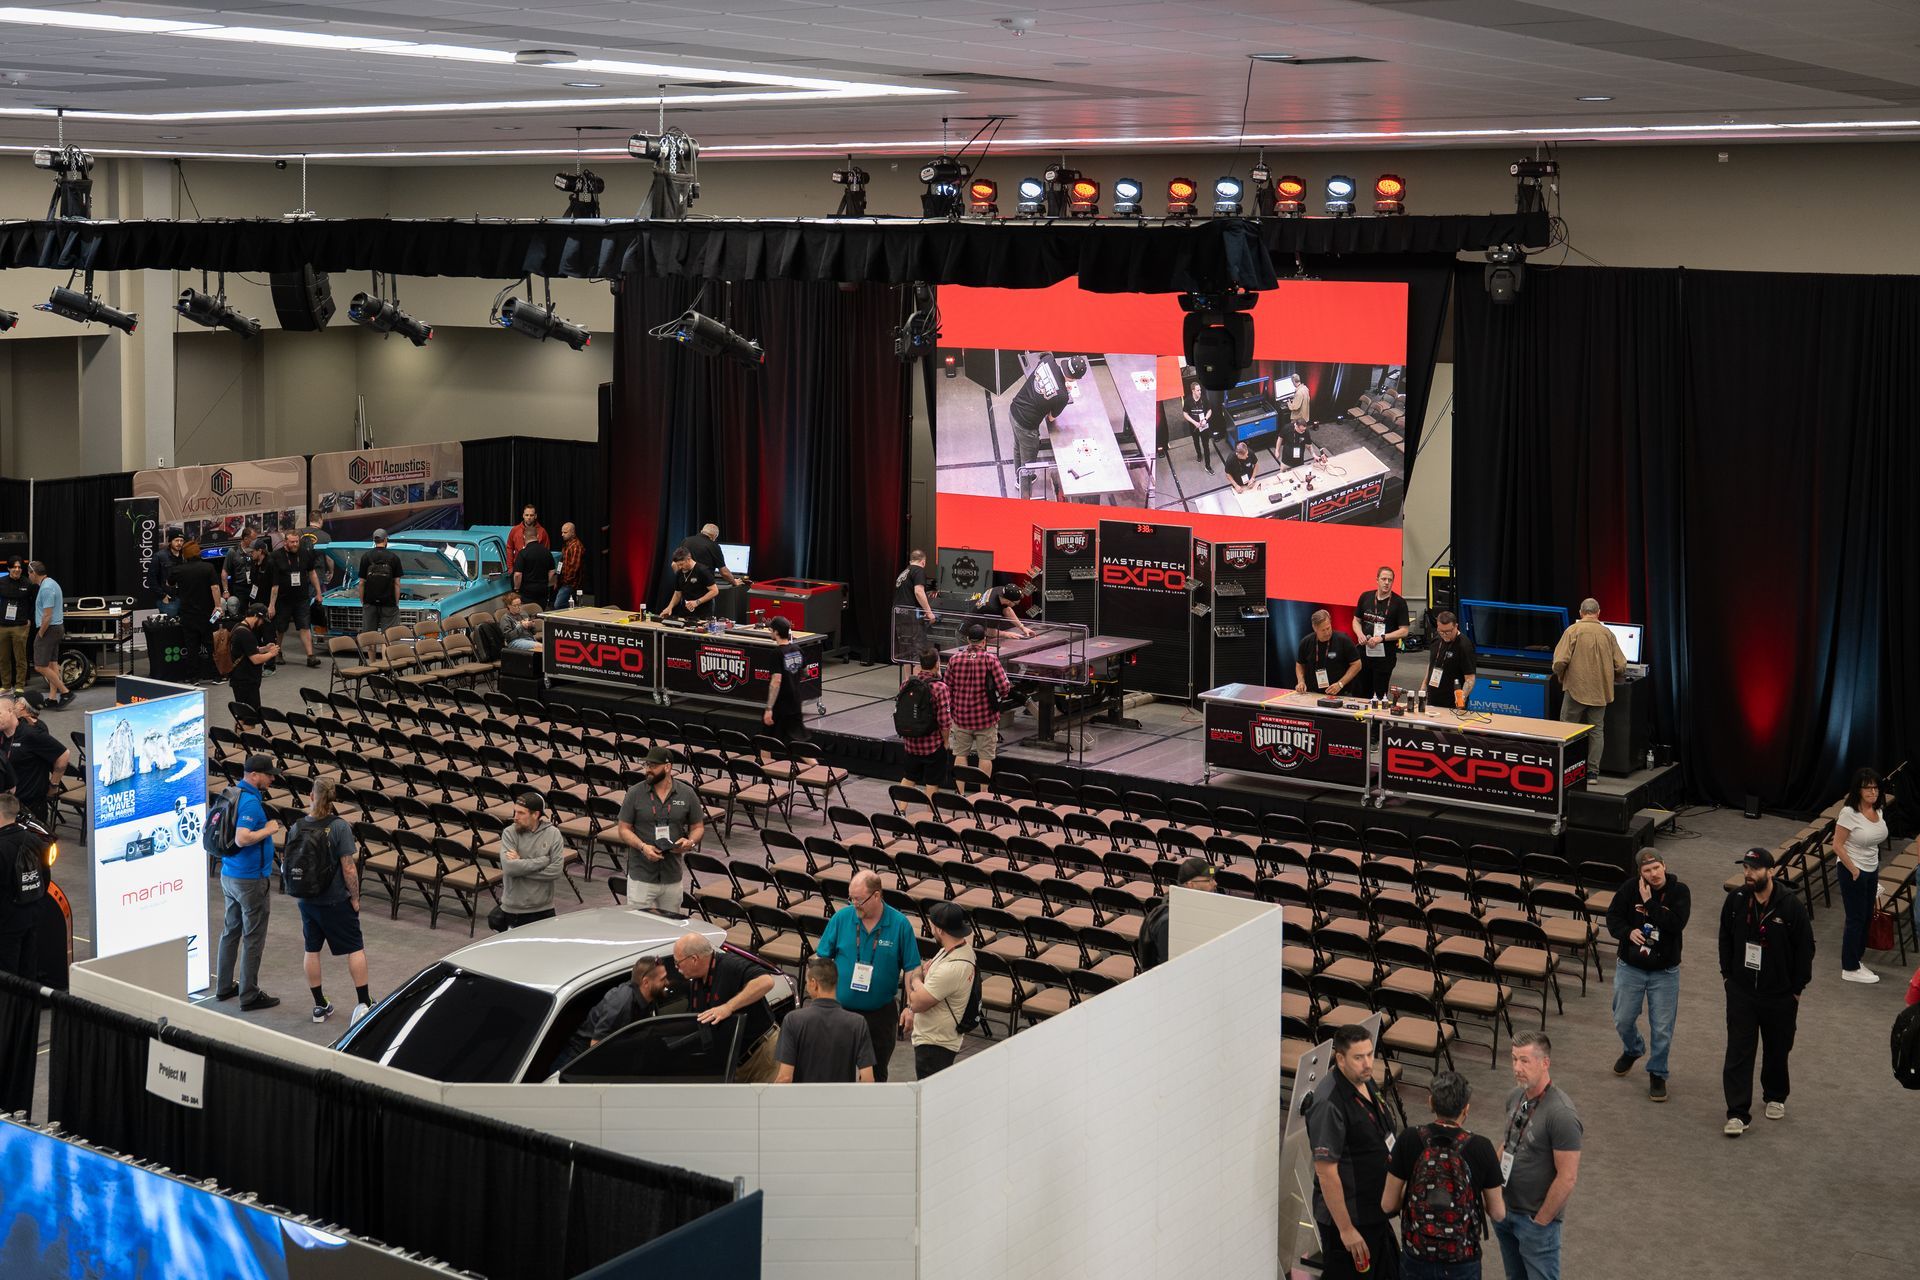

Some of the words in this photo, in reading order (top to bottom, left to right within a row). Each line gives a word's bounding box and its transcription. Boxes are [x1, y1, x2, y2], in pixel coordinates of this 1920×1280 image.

[182, 491, 261, 512] AUTOMOTIVE
[1309, 484, 1380, 517] EXPO
[1310, 479, 1381, 507] MASTERTECH
[1056, 536, 1074, 546] BUILD
[1075, 536, 1085, 546] OFF
[139, 520, 156, 589] diofrog
[1103, 557, 1185, 570] MASTERTECH
[1226, 550, 1244, 560] BUILD
[1244, 550, 1255, 559] OFF
[1103, 564, 1186, 590] EXPO
[554, 628, 644, 648] MASTERTECH
[555, 639, 643, 672] EXPO
[700, 655, 728, 673] BUILD
[728, 659, 746, 678] OFF
[1210, 730, 1243, 742] EXPO
[1254, 726, 1292, 748] BUILD
[1293, 731, 1316, 754] OFF
[1328, 746, 1362, 758] EXPO
[1387, 737, 1553, 767] MASTERTECH
[1387, 748, 1554, 794] EXPO
[1387, 774, 1414, 782] WHERE
[1417, 778, 1483, 792] PROFESSIONALS
[101, 790, 135, 807] POWER
[108, 799, 135, 813] WAVES
[122, 879, 183, 906] marine
[159, 1062, 179, 1081] Project
[180, 1070, 187, 1083] M
